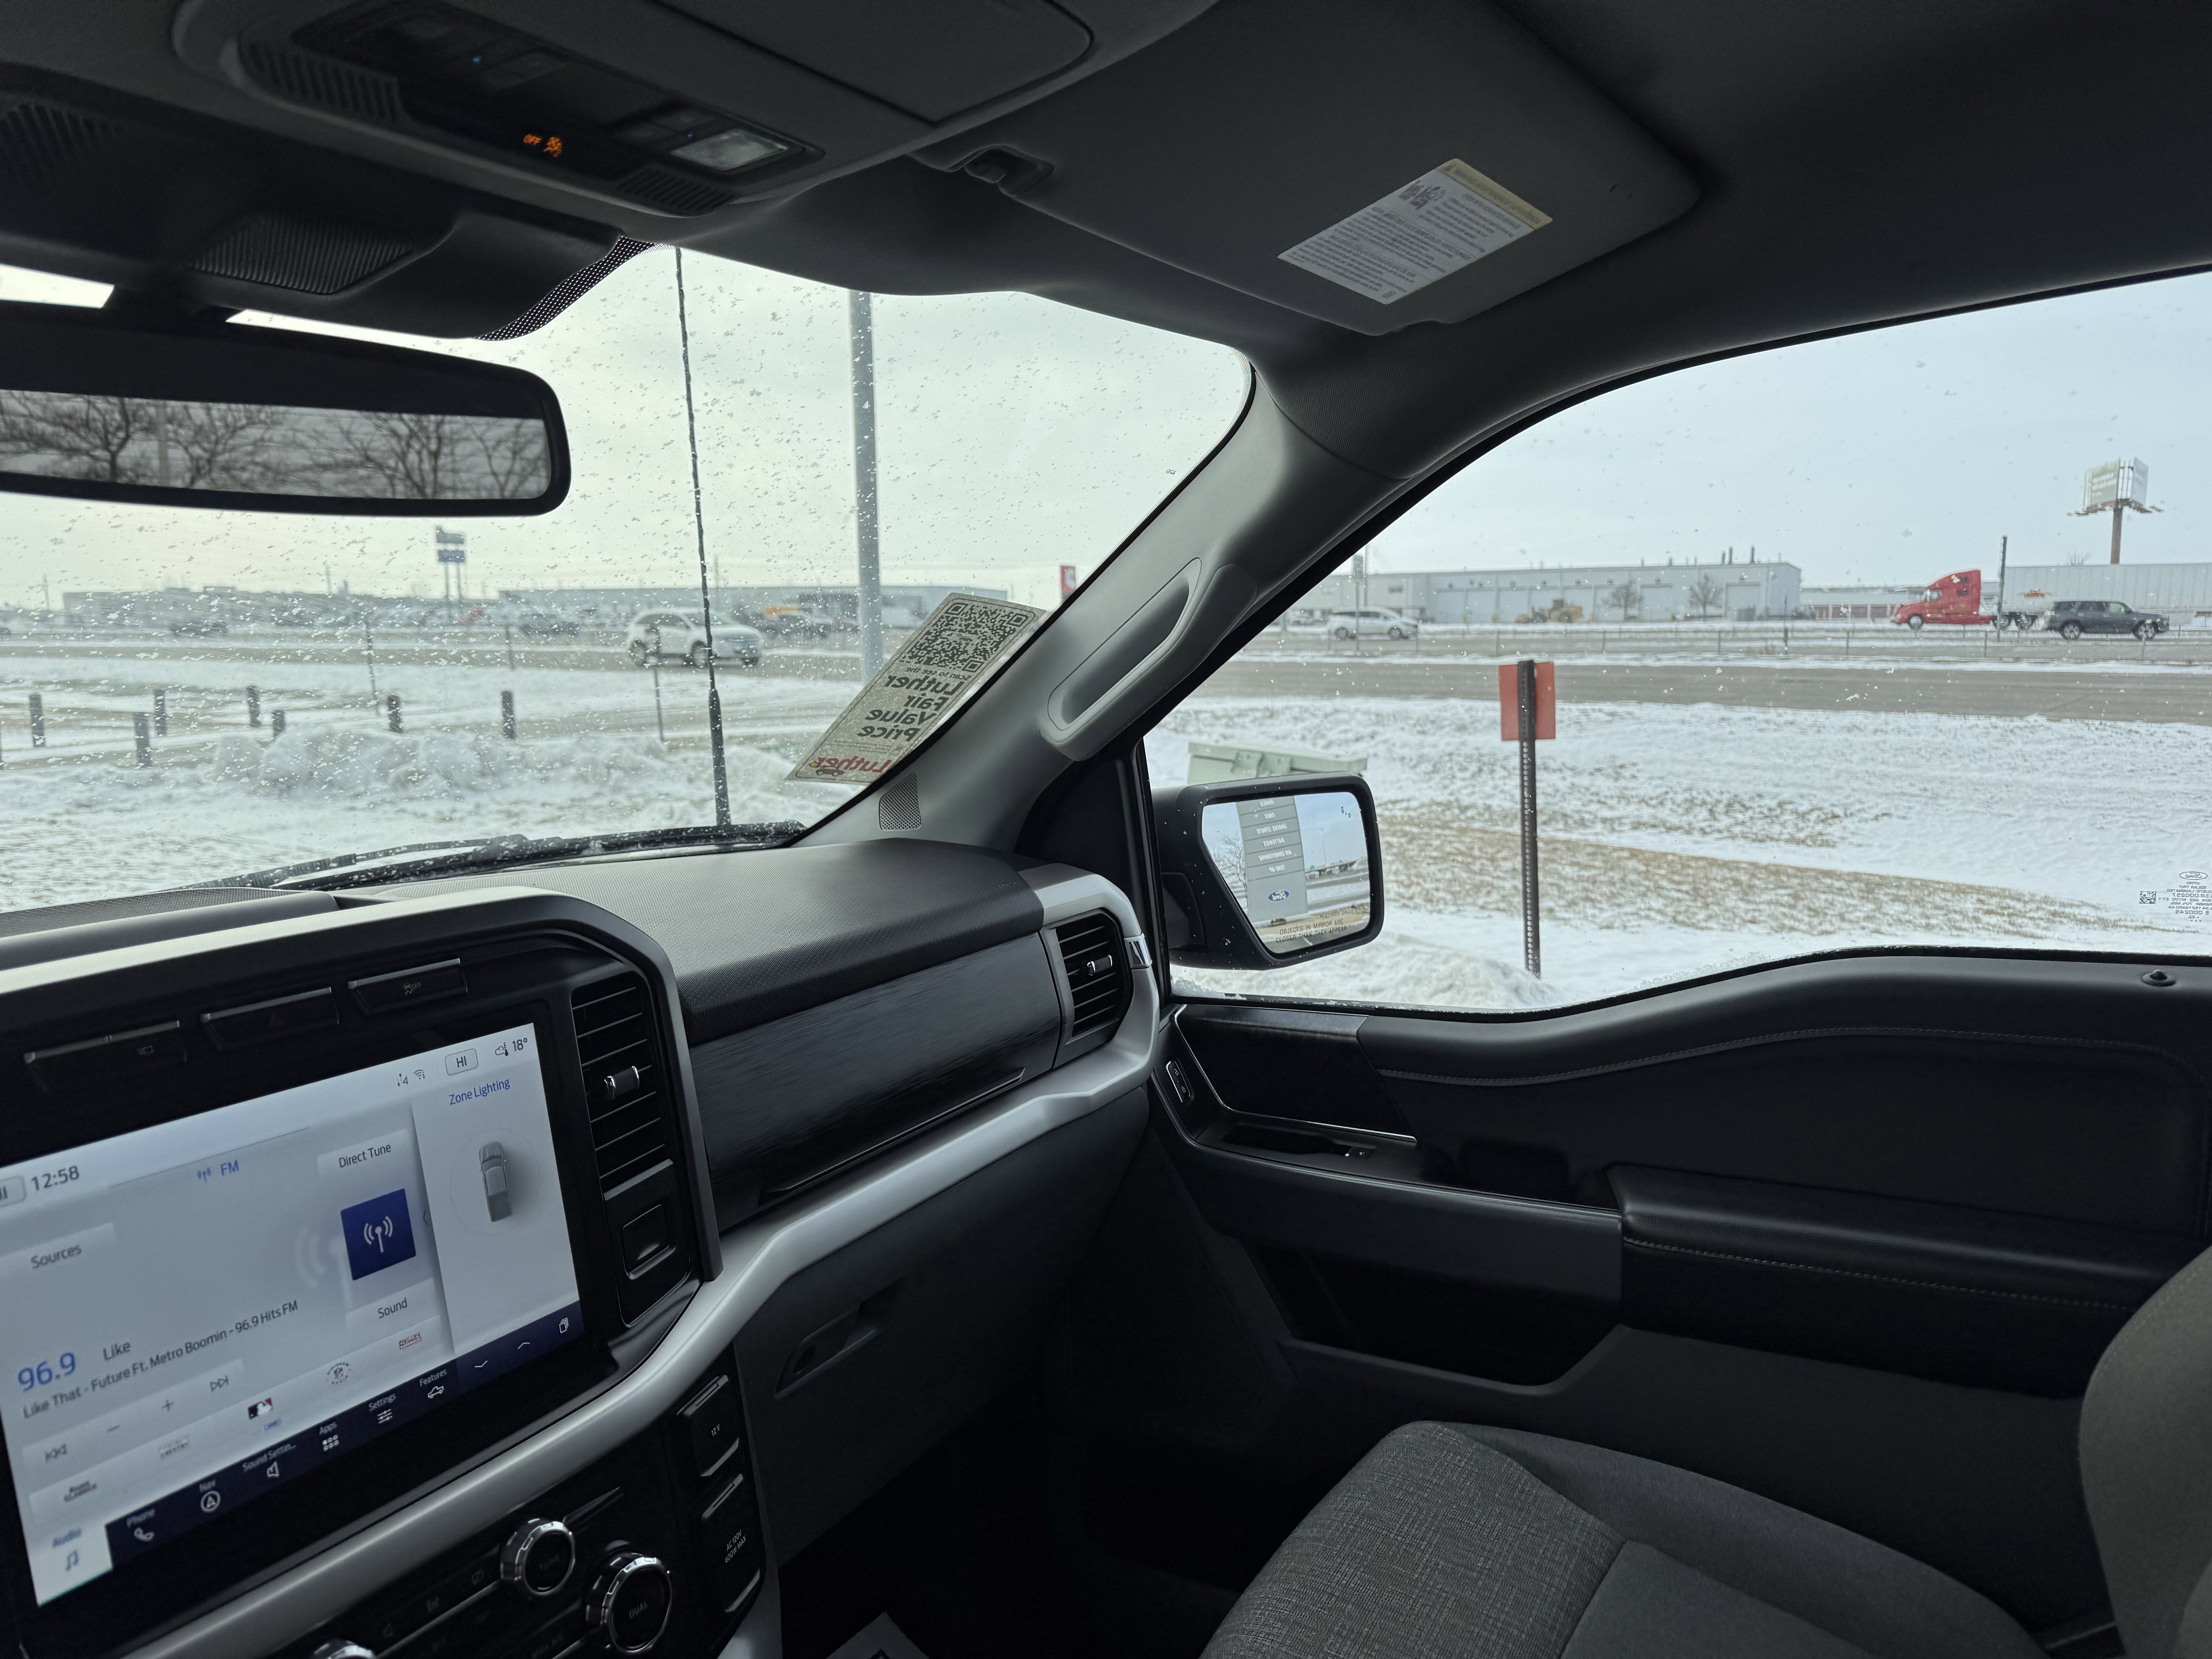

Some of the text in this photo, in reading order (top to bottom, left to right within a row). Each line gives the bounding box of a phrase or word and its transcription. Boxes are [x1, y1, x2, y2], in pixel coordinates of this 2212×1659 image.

[1279, 926, 1303, 935] OBJECTS
[1313, 921, 1332, 929] MIRROR
[1276, 935, 1296, 943] CLOSER
[512, 1037, 528, 1052] 18°
[456, 1056, 467, 1068] HI
[449, 1079, 510, 1105] Zone Lighting
[338, 1144, 392, 1168] Direct Tune
[220, 1160, 240, 1176] FM
[31, 1165, 80, 1192] 12:58
[31, 1244, 82, 1269] Sources
[378, 1297, 408, 1318] Sound
[23, 1400, 49, 1419] Like
[51, 1385, 81, 1407] That
[90, 1368, 131, 1392] Future
[150, 1347, 183, 1369] Metro
[184, 1329, 228, 1353] Boomin
[235, 1315, 259, 1333] 96.9
[260, 1307, 282, 1324] Hits
[282, 1300, 298, 1315] FM
[103, 1341, 131, 1361] Like
[18, 1351, 76, 1392] 96.9
[419, 1368, 447, 1387] Features
[368, 1393, 397, 1412] Settings
[319, 1420, 337, 1436] Apps
